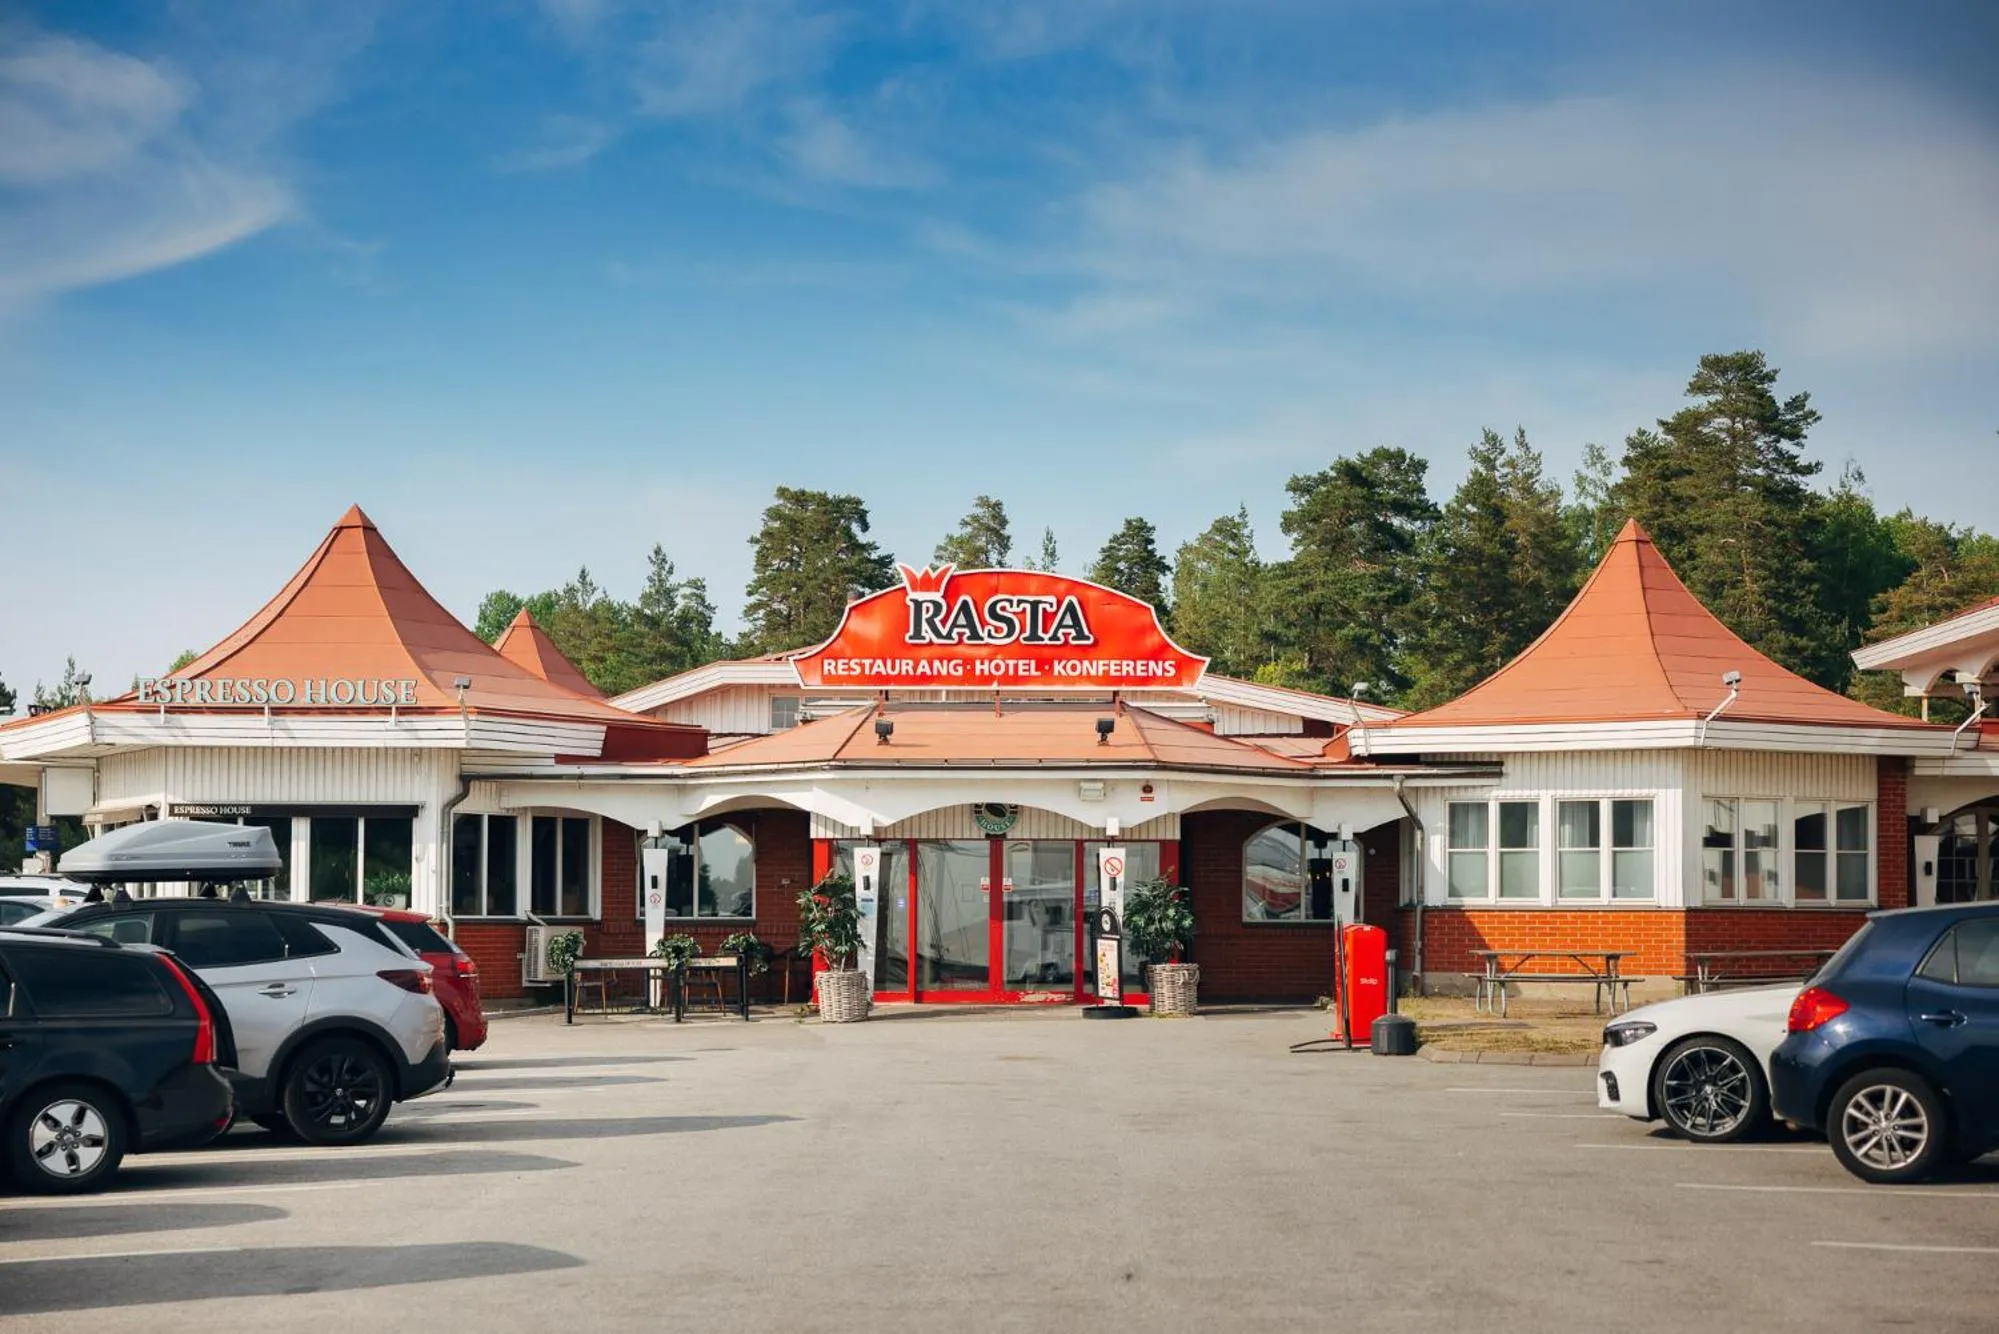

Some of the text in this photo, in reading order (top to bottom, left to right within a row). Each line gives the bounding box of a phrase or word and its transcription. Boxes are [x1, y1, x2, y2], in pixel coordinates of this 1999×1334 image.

[907, 596, 1092, 643] RASTA
[823, 658, 1177, 678] RESTAURANG HOTEL KONFERENS
[137, 678, 418, 705] ESPRESSO HOUSE
[173, 805, 252, 815] ESPRESSO HOUSE
